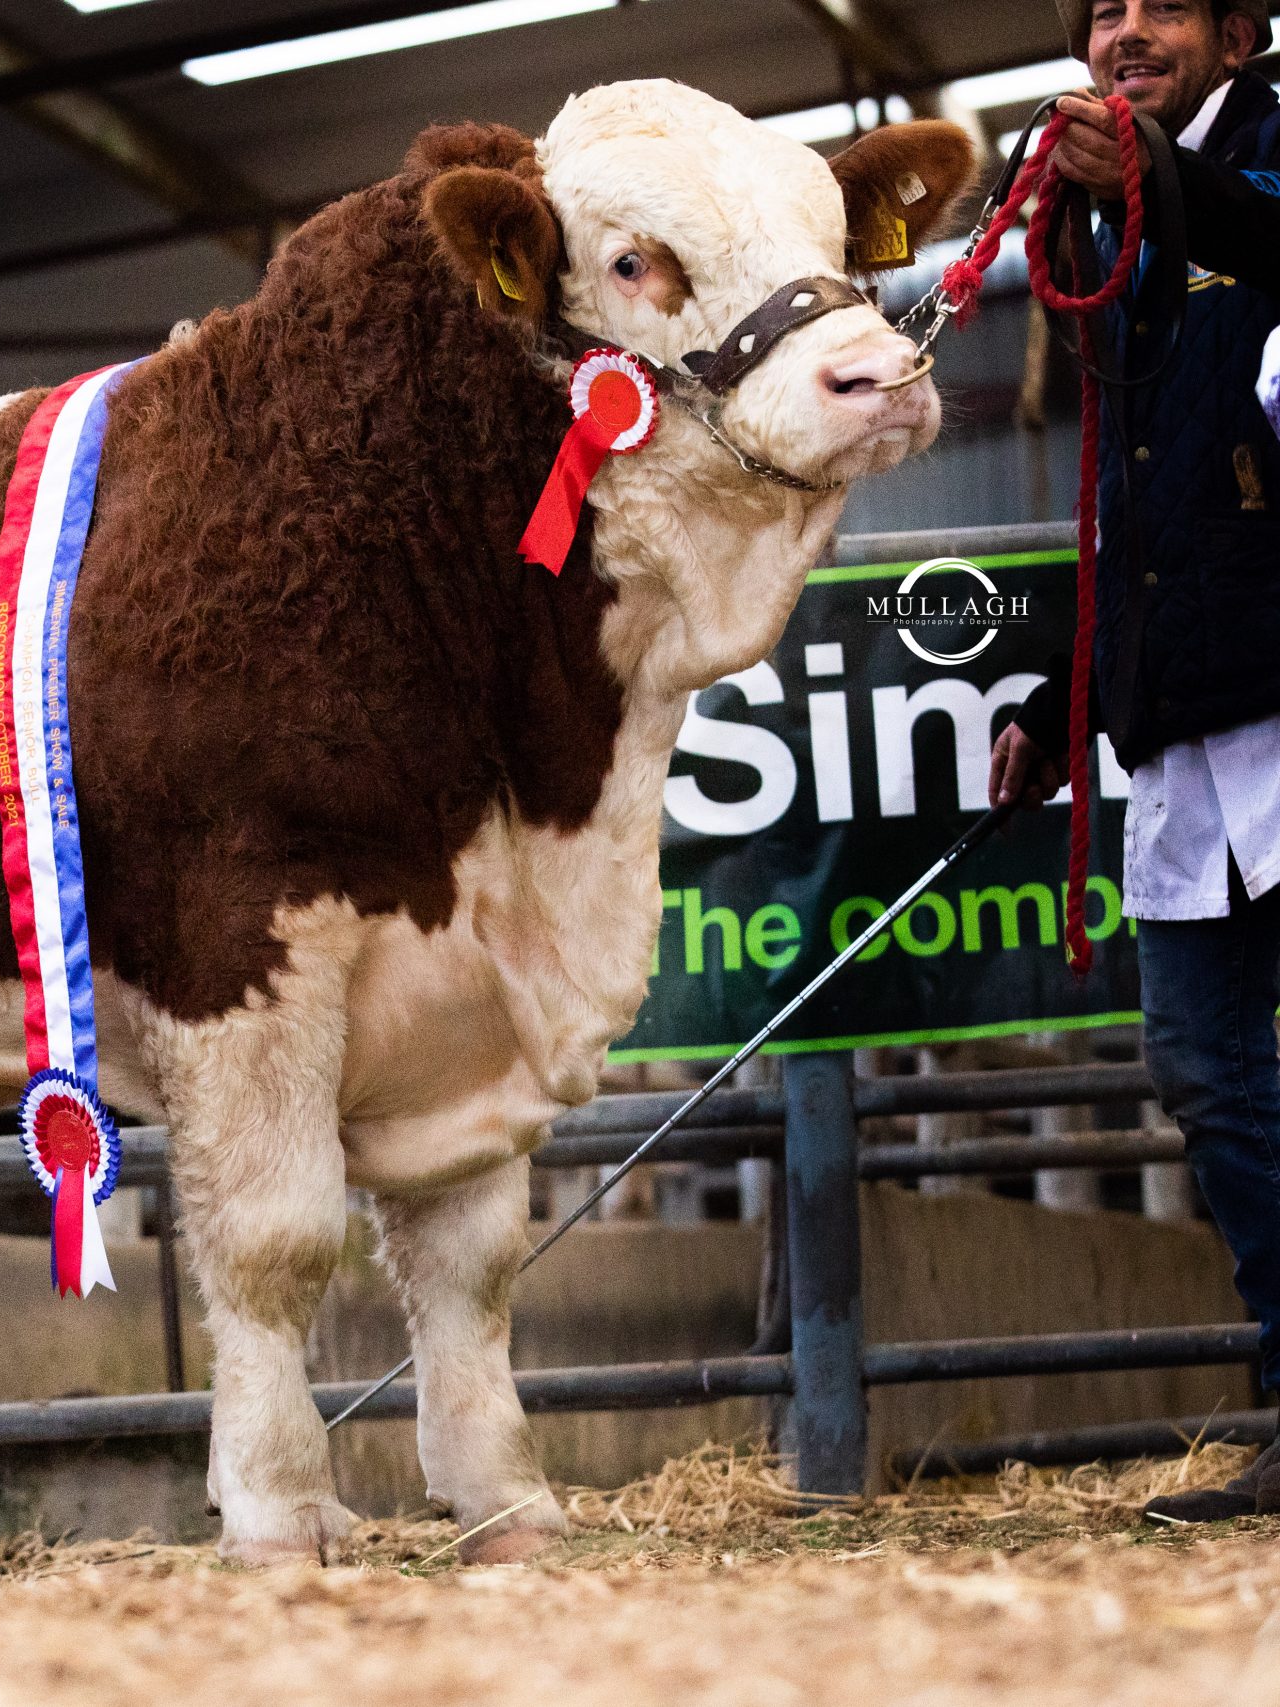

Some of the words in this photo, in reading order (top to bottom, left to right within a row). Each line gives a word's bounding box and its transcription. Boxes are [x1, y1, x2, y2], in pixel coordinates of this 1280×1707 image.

[49, 580, 67, 652] SIMMENTAL
[22, 614, 36, 693] CHAMPION
[48, 658, 59, 721] PREMIER
[23, 701, 35, 759] SENIOR
[51, 728, 63, 770] SHOW
[663, 643, 1129, 836] Sim
[4, 794, 18, 827] 2021
[28, 768, 40, 806] BULL
[54, 778, 63, 788] &
[57, 794, 69, 829] SALE
[829, 875, 1137, 963] comp
